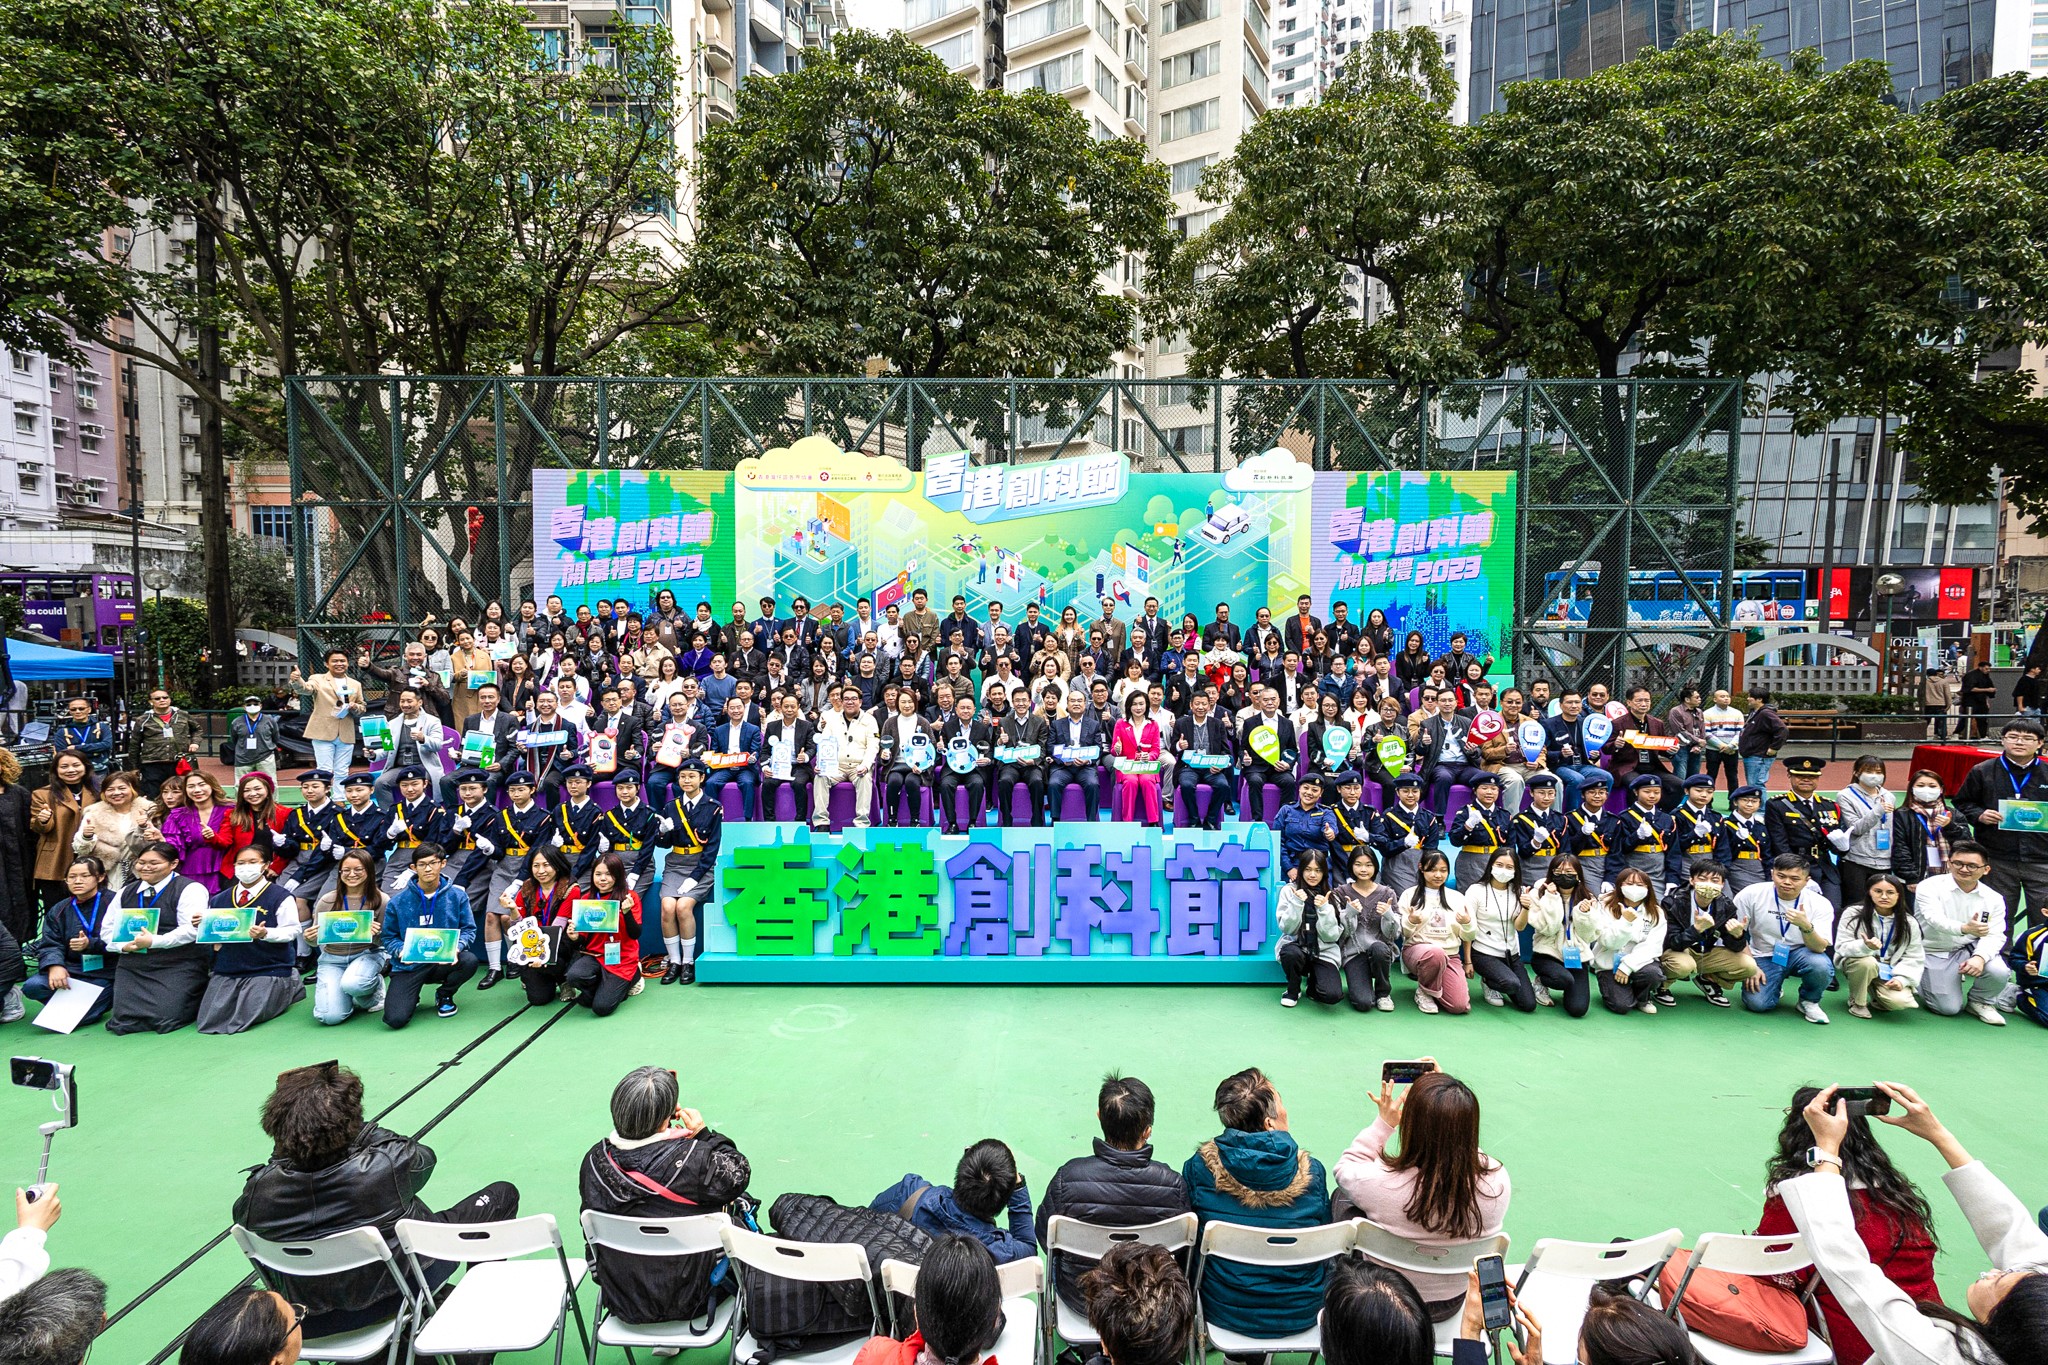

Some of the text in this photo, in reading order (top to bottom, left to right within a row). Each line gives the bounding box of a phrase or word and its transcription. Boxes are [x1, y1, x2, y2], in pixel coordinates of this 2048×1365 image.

[926, 451, 1119, 512] 香港創科節
[551, 504, 713, 553] 香港創科節
[1329, 506, 1494, 555] 香港創科節
[561, 554, 704, 587] 開幕禮 2023
[1338, 555, 1482, 590] 開幕禮 2023
[37, 607, 62, 615] could
[722, 841, 1271, 957] 香港創科節
